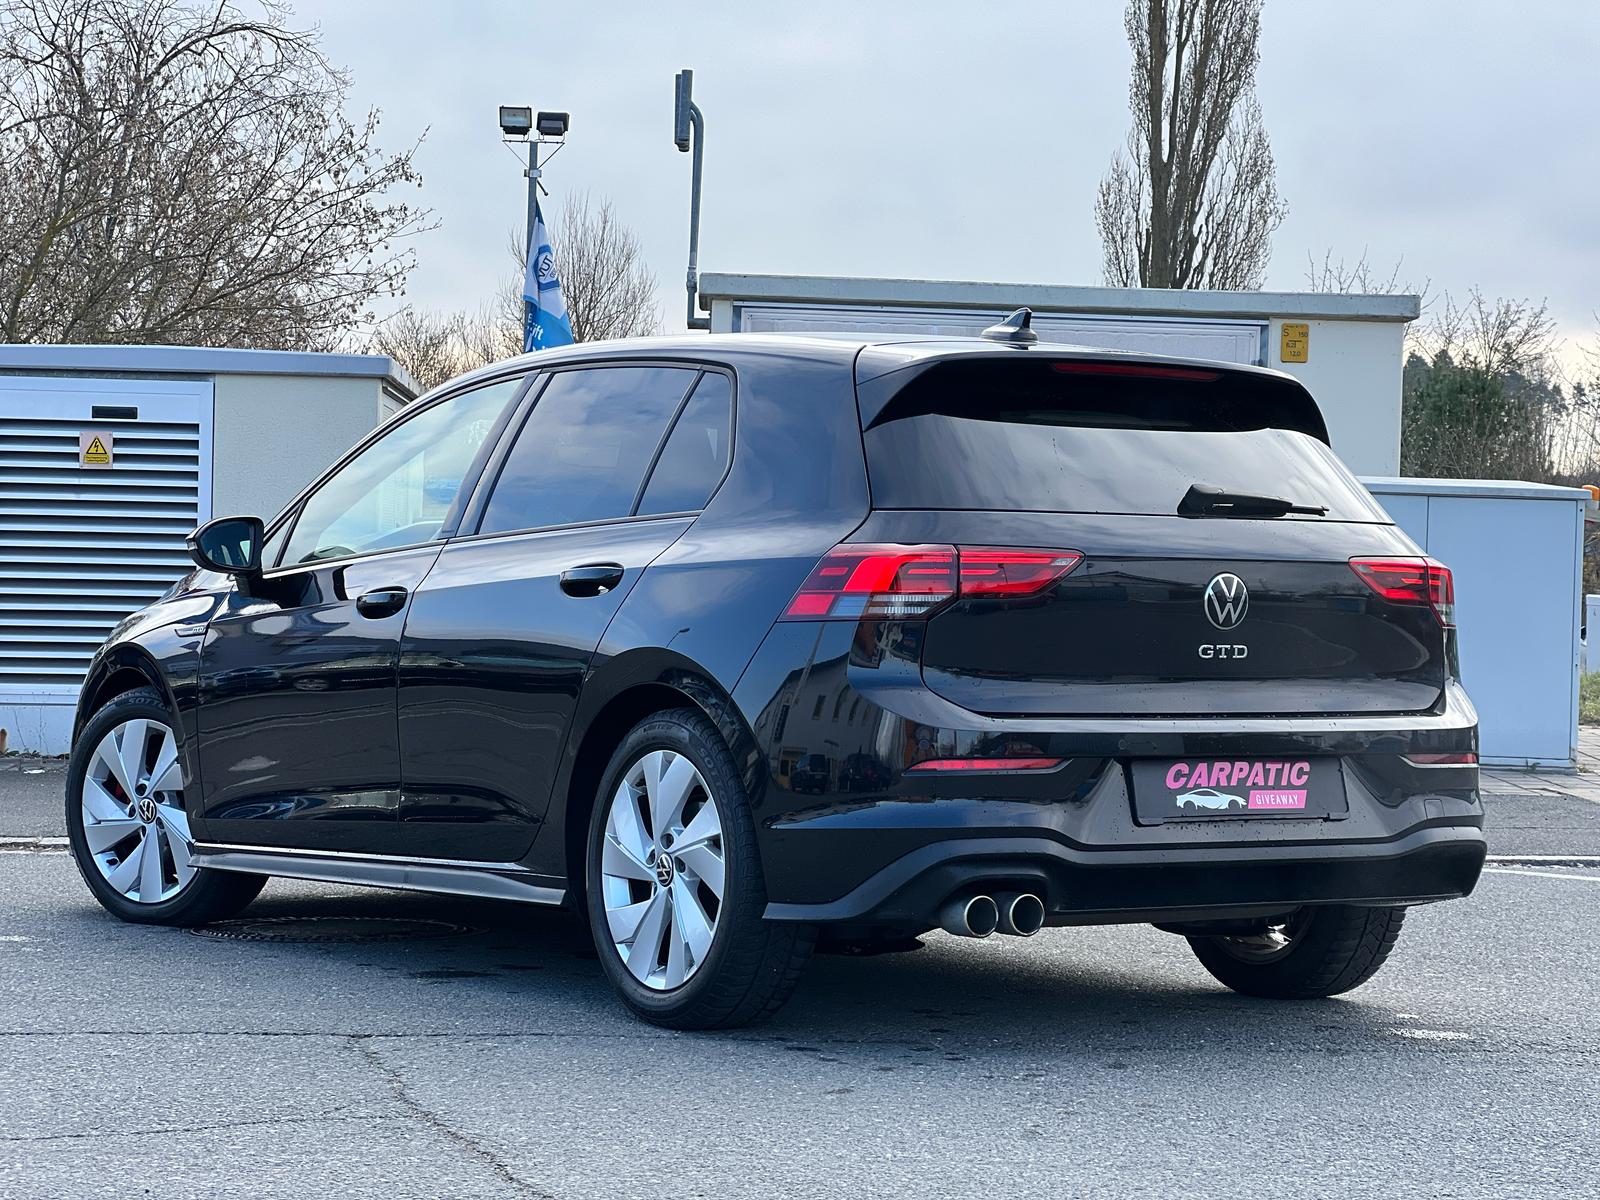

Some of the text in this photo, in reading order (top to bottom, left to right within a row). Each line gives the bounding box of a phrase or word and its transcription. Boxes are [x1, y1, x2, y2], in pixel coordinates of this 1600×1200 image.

[1198, 644, 1249, 659] GTD
[1165, 761, 1311, 790] CARPATIC
[1255, 794, 1299, 806] GIVEAWAY
